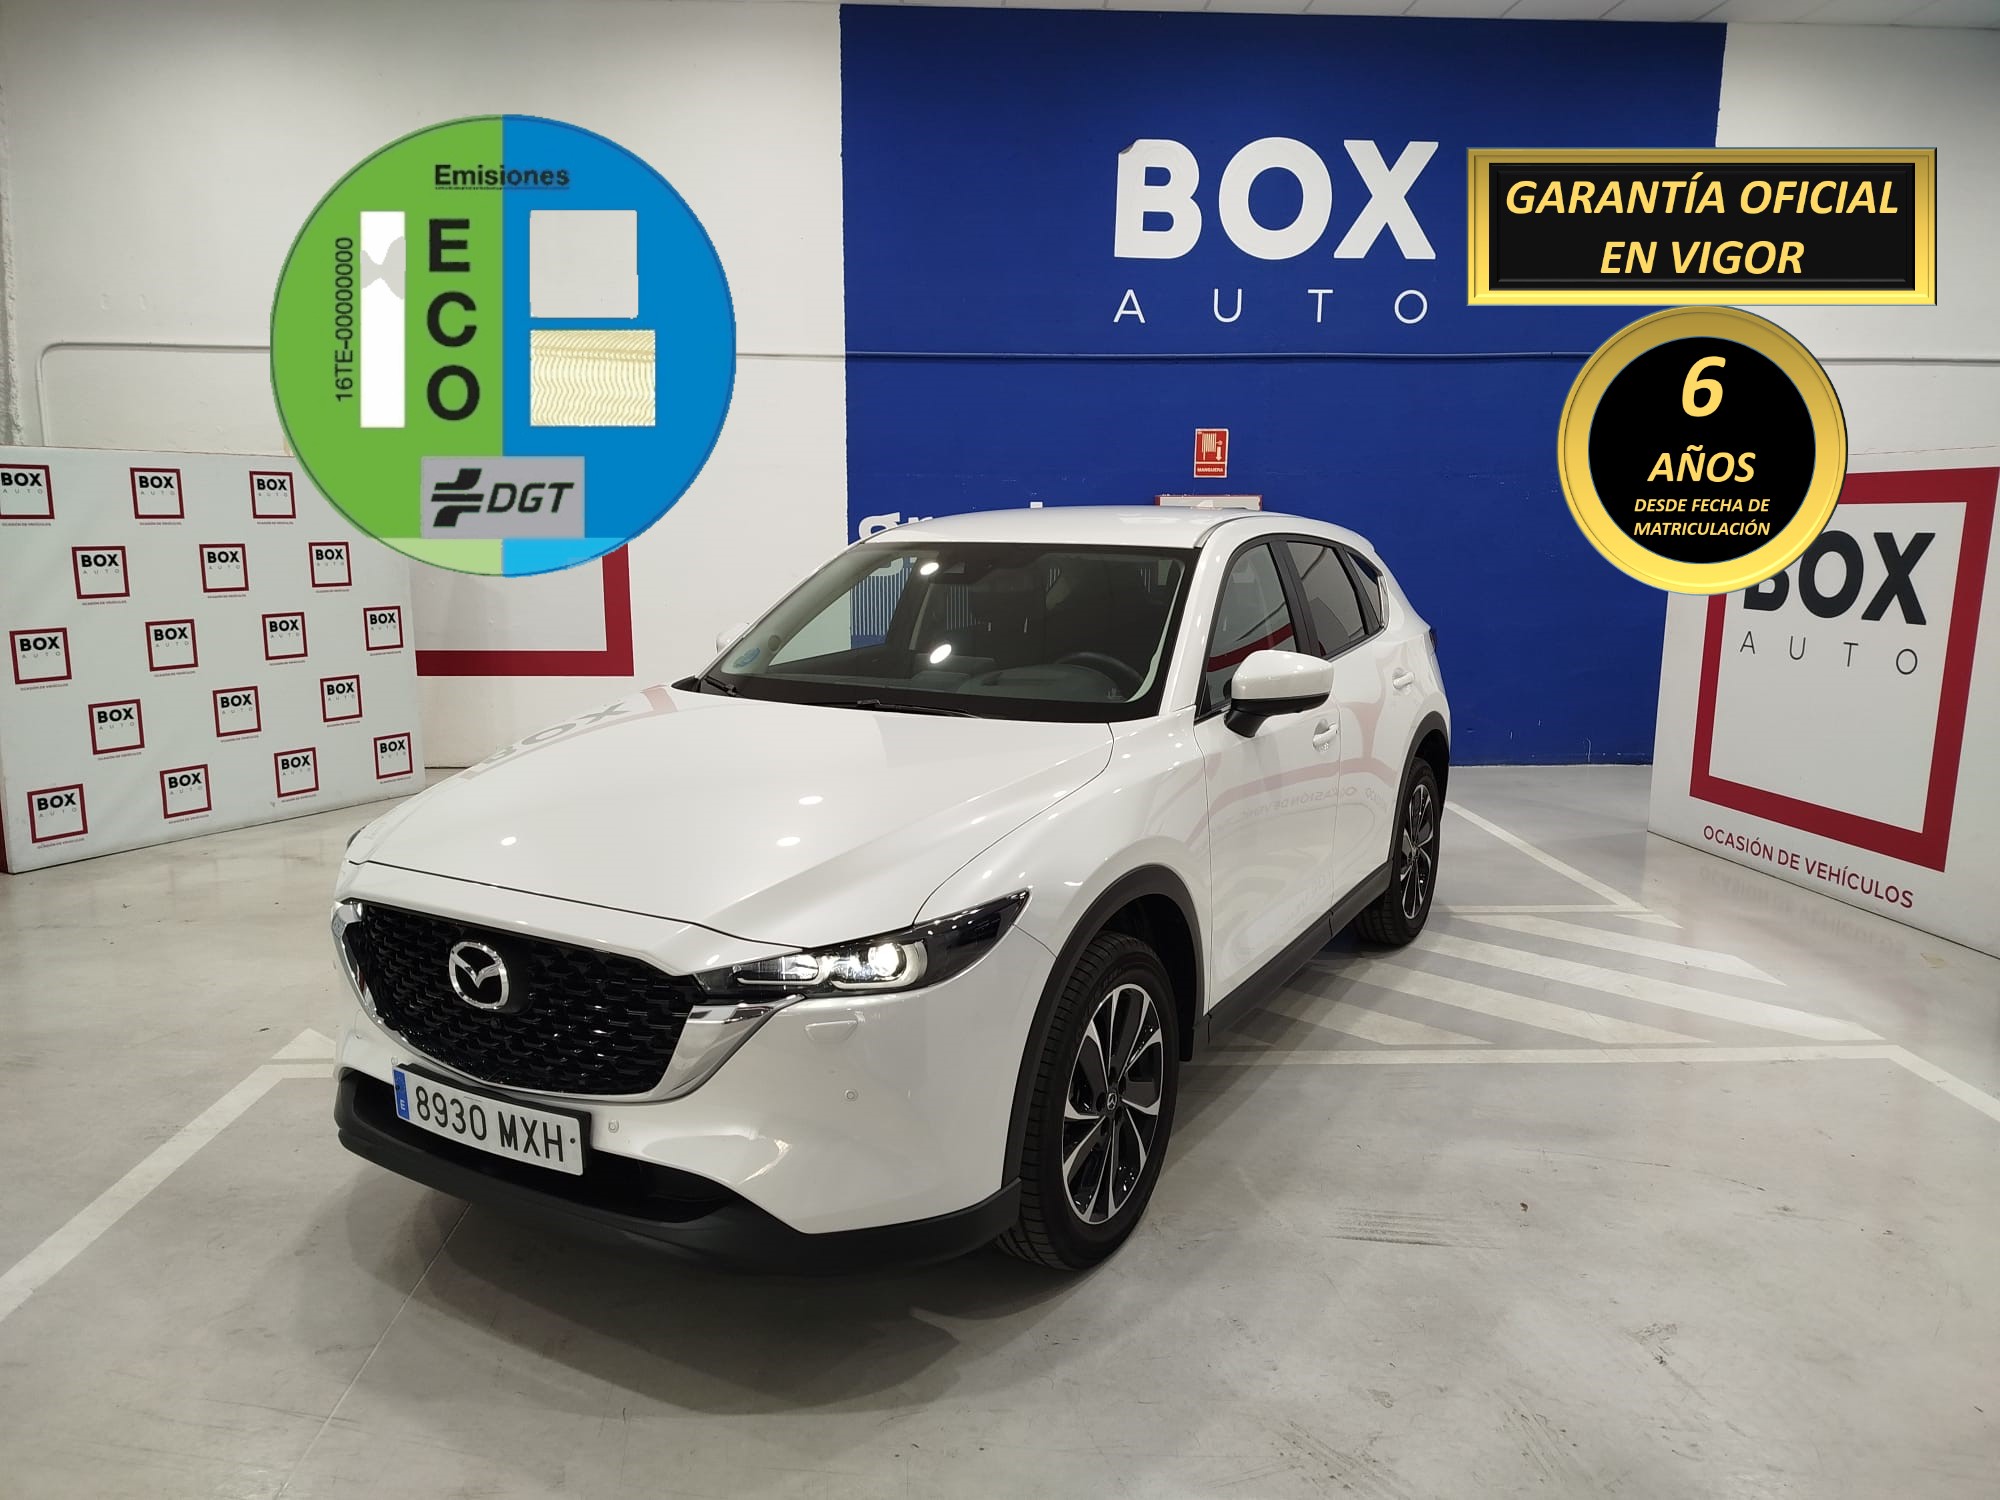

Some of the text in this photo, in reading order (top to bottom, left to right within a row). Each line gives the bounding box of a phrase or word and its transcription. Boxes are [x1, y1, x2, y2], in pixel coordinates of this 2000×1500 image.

[1113, 136, 1439, 261] BOX
[1113, 288, 1428, 325] AUTO
[1, 472, 43, 487] BOX
[138, 475, 175, 489] BOX
[256, 478, 288, 491] BOX
[80, 554, 120, 568] BOX
[207, 550, 241, 564] BOX
[315, 548, 344, 561] BOX
[269, 618, 300, 633] BOX
[370, 612, 397, 625] BOX
[153, 626, 188, 642] BOX
[19, 635, 61, 652] BOX
[1739, 630, 1919, 676] AUTO
[326, 681, 355, 696] BOX
[220, 693, 253, 709] BOX
[97, 706, 135, 724] BOX
[379, 738, 406, 754] BOX
[281, 754, 311, 770] BOX
[167, 771, 203, 789] BOX
[36, 791, 77, 812] BOX
[1702, 824, 1915, 909] OCASIÓN DE VEHÍCULOS
[415, 1085, 565, 1163] 8930 MXH
